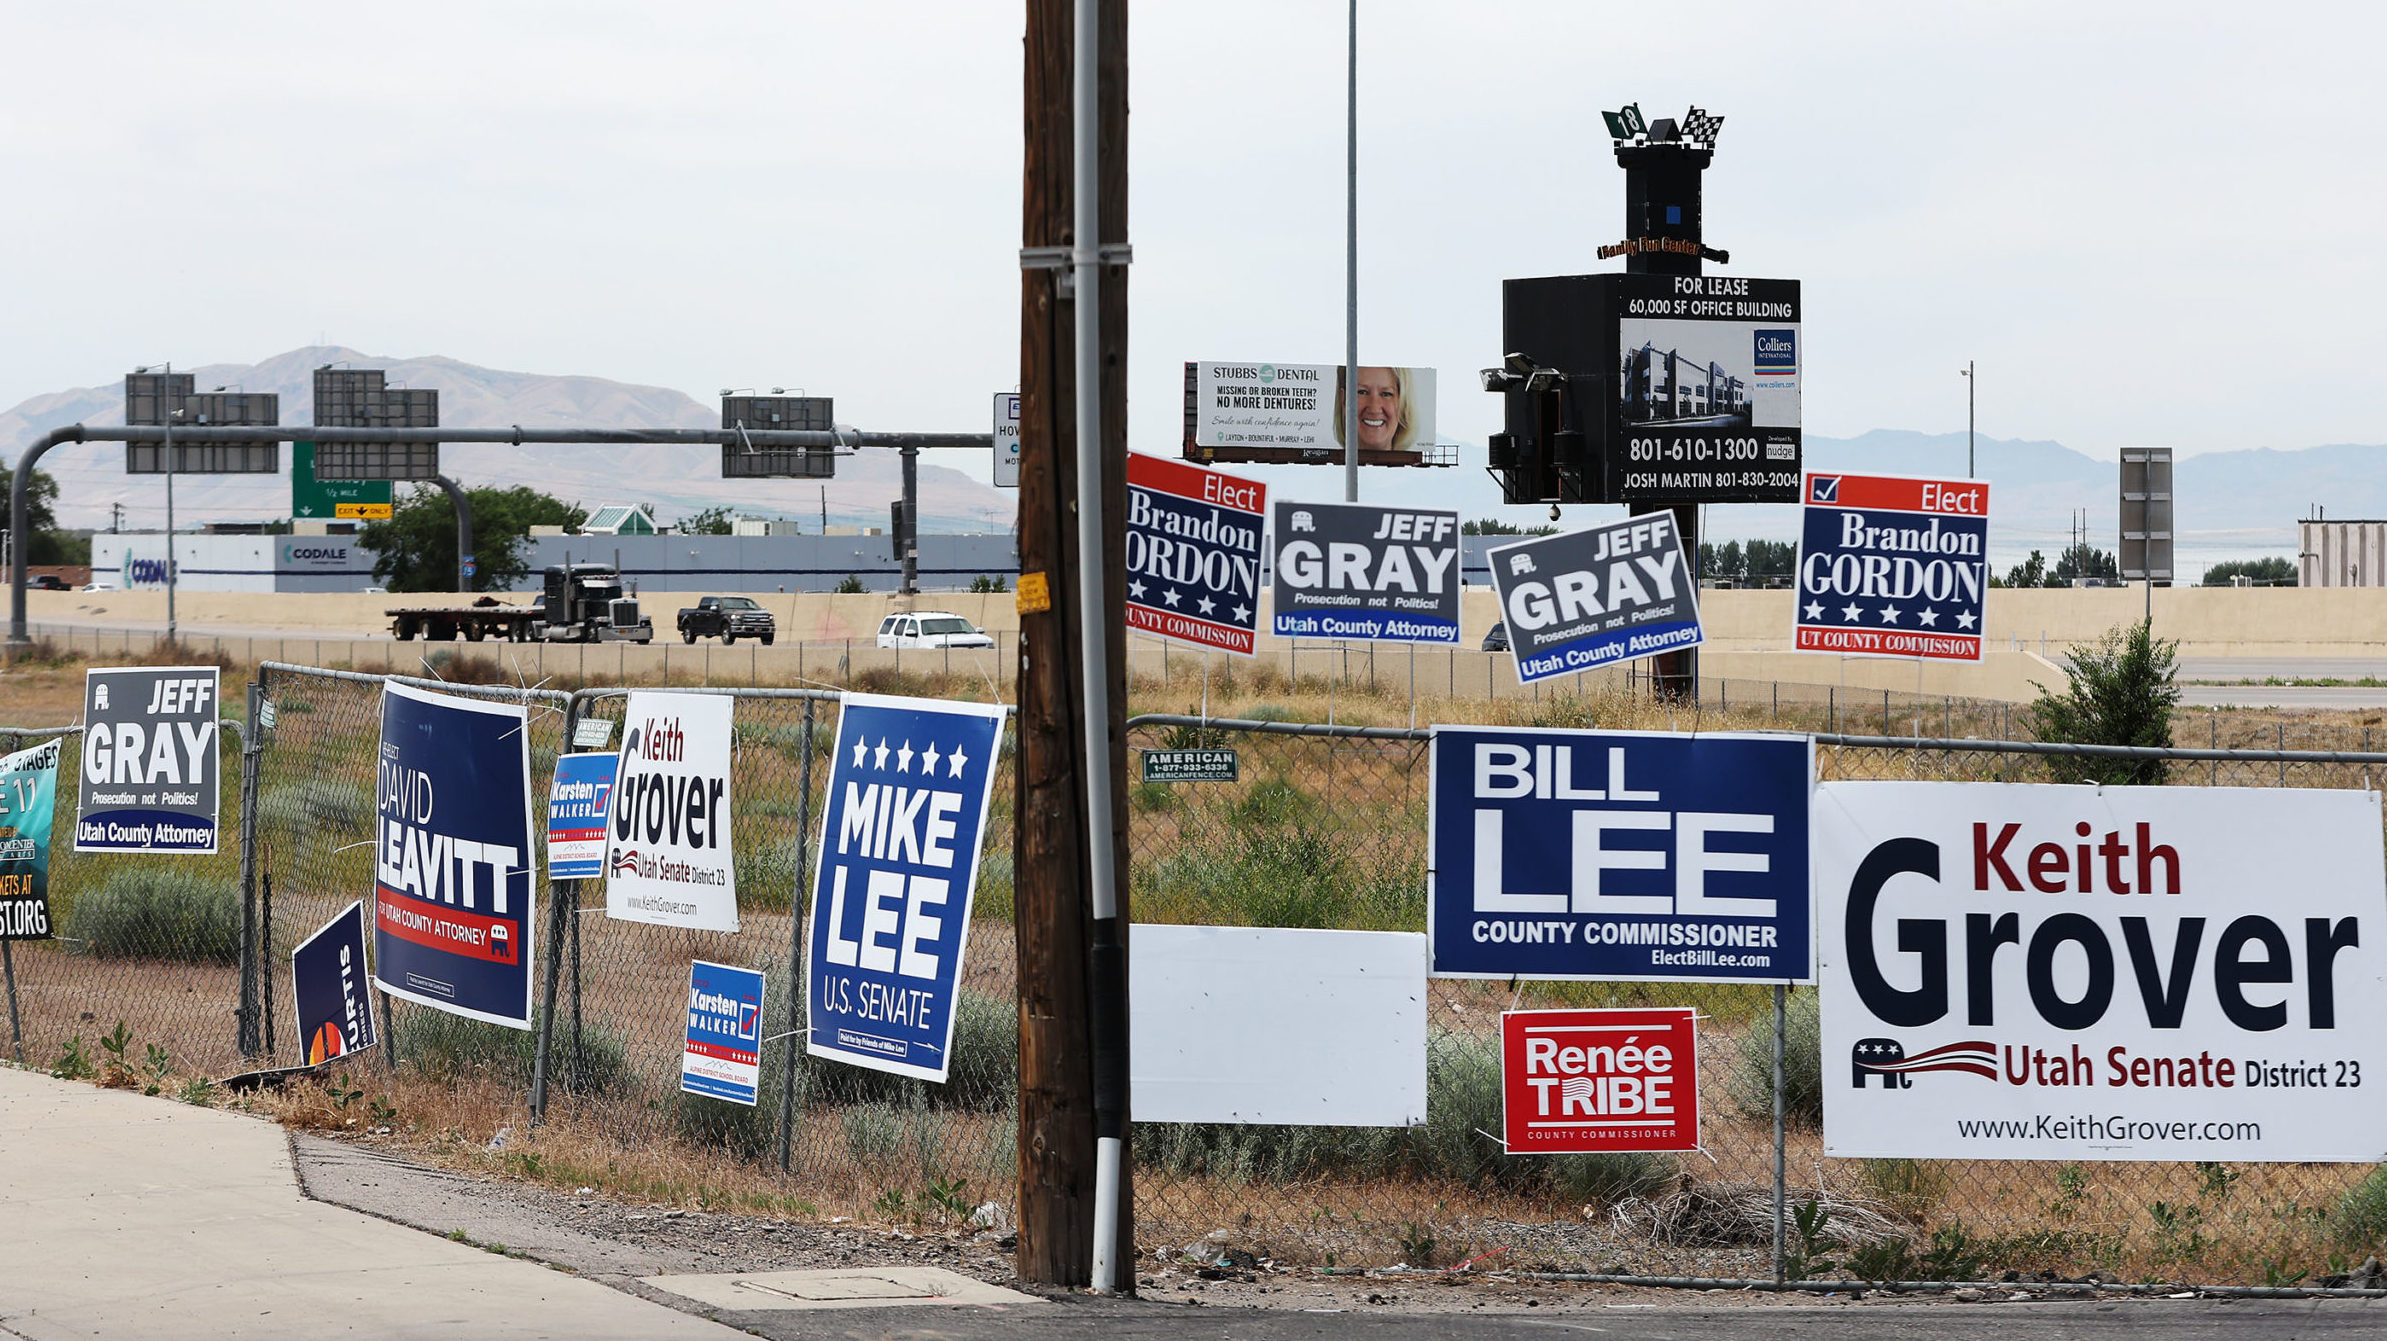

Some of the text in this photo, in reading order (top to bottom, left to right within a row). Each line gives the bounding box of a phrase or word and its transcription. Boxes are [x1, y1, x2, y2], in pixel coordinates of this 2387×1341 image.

[1617, 108, 1640, 137] 18
[1599, 237, 1700, 260] Family Fun Center
[1675, 277, 1748, 296] FOR LEASE
[1629, 299, 1792, 318] 60,000 SF OFFICE BUILDING
[1758, 337, 1792, 352] Colliers
[1213, 367, 1320, 382] STUBBS DENTAL
[1216, 396, 1316, 411] NO MORE DENTURES!
[1217, 385, 1317, 398] MISSING OR BROKEN TEETH?
[1211, 415, 1320, 431] Smile with confidence again!
[1225, 434, 1244, 442] LAYTON
[1629, 438, 1758, 461] 801-610-1300
[1767, 445, 1793, 459] nudge
[1203, 474, 1257, 511] Elect
[1624, 472, 1798, 489] JOSH MARTIN 801-830-2004
[1920, 483, 1980, 514] Elect
[1127, 489, 1257, 553] Brandon
[1373, 513, 1455, 542] JEFF
[1840, 511, 1981, 557] Brandon
[293, 548, 347, 559] CODALE
[1593, 518, 1670, 563] JEFF
[1126, 530, 1259, 600] ORDON
[1278, 540, 1457, 594] GRAY
[1803, 551, 1985, 605] GORDON
[1295, 592, 1439, 611] Prosecution not Politics!
[1508, 549, 1680, 631] GRAY
[1126, 607, 1250, 649] UNTY COMMISSION
[1276, 615, 1457, 642] Utah County Attorney
[1533, 603, 1675, 646] Prosecution not Politics!
[1520, 625, 1698, 679] Utah County Attorney
[1800, 631, 1976, 656] UT COUNTY COMMISSION
[147, 679, 214, 714] JEFF
[85, 722, 214, 785] GRAY
[642, 717, 683, 763] Keith
[1149, 753, 1232, 764] AMERICAN
[1154, 764, 1228, 772] 1-877-933-6336
[1473, 742, 1660, 801] BILL
[13, 777, 36, 813] 11
[92, 791, 199, 806] Prosecution not Politics!
[380, 759, 433, 825] DAVID
[552, 780, 593, 801] Karsten
[615, 727, 724, 850] Grover
[550, 803, 592, 819] WALKER
[837, 781, 963, 869] MIKE
[79, 822, 213, 848] Utah County Attorney
[377, 814, 518, 914] LEAVITT
[638, 852, 726, 887] Utah Senate District 23
[1473, 808, 1777, 918] LEE
[1973, 821, 2181, 895] Keith
[21, 874, 33, 895] AT
[627, 894, 697, 916] www.KeithGrover.com
[386, 903, 401, 925] UTAH
[402, 909, 433, 934] COUNTY
[434, 919, 487, 947] ATTORNEY
[826, 864, 950, 980] LEE
[1472, 921, 1777, 948] COUNTY COMMISSIONER
[1844, 837, 2359, 1032] Grover
[1651, 948, 1771, 968] ElectBillLee.com
[690, 987, 738, 1018] Karsten
[824, 974, 934, 1031] U.S. SENATE
[689, 1012, 737, 1037] WALKER
[884, 1041, 895, 1052] Mike
[895, 1044, 905, 1054] Lee
[1525, 1034, 1673, 1074] Renée
[2004, 1043, 2361, 1088] Utah Senate District 23
[1526, 1075, 1674, 1116] TRIBE
[1527, 1129, 1677, 1140] COUNTY COMMISSIONER
[1957, 1115, 2261, 1142] www.KeithGrover.com
